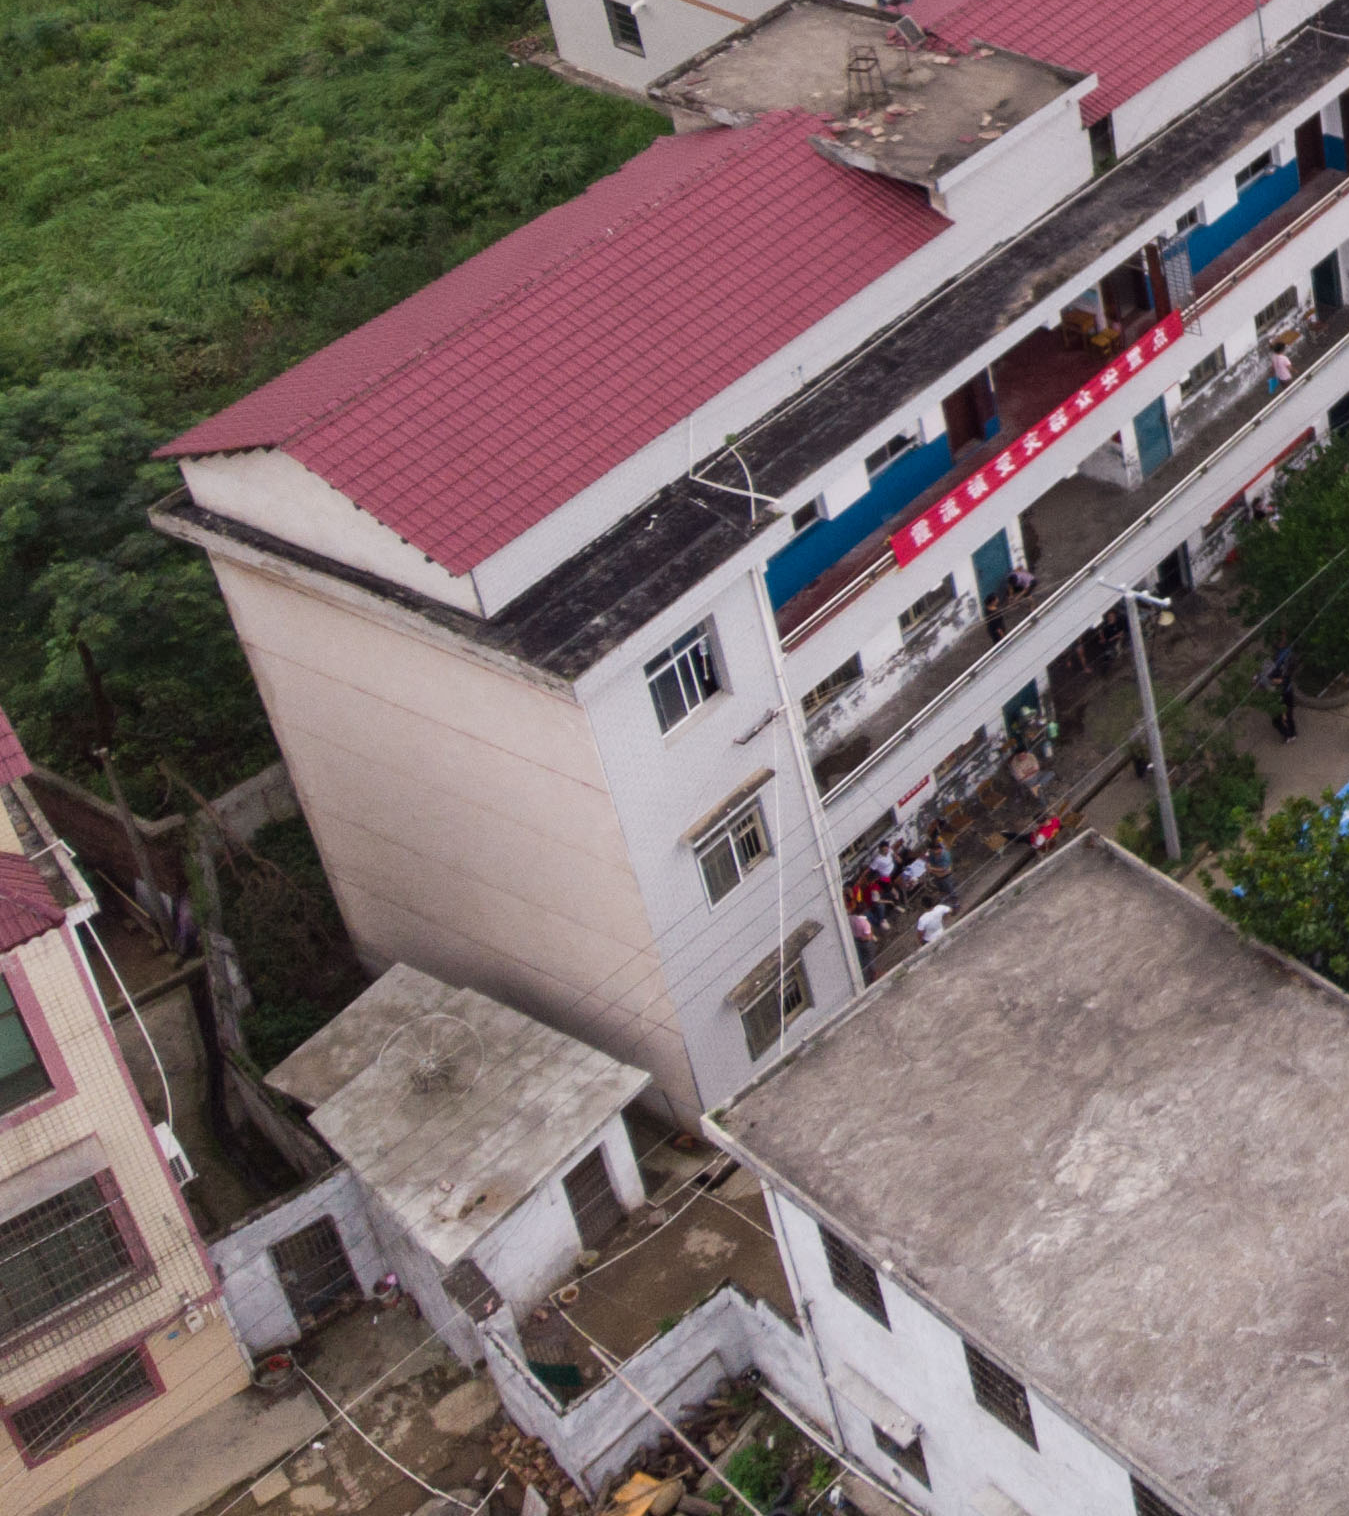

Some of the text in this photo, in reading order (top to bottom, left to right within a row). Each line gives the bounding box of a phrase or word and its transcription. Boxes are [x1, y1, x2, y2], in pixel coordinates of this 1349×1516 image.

[909, 328, 1169, 548] 霞流镇受灾群众安置点
